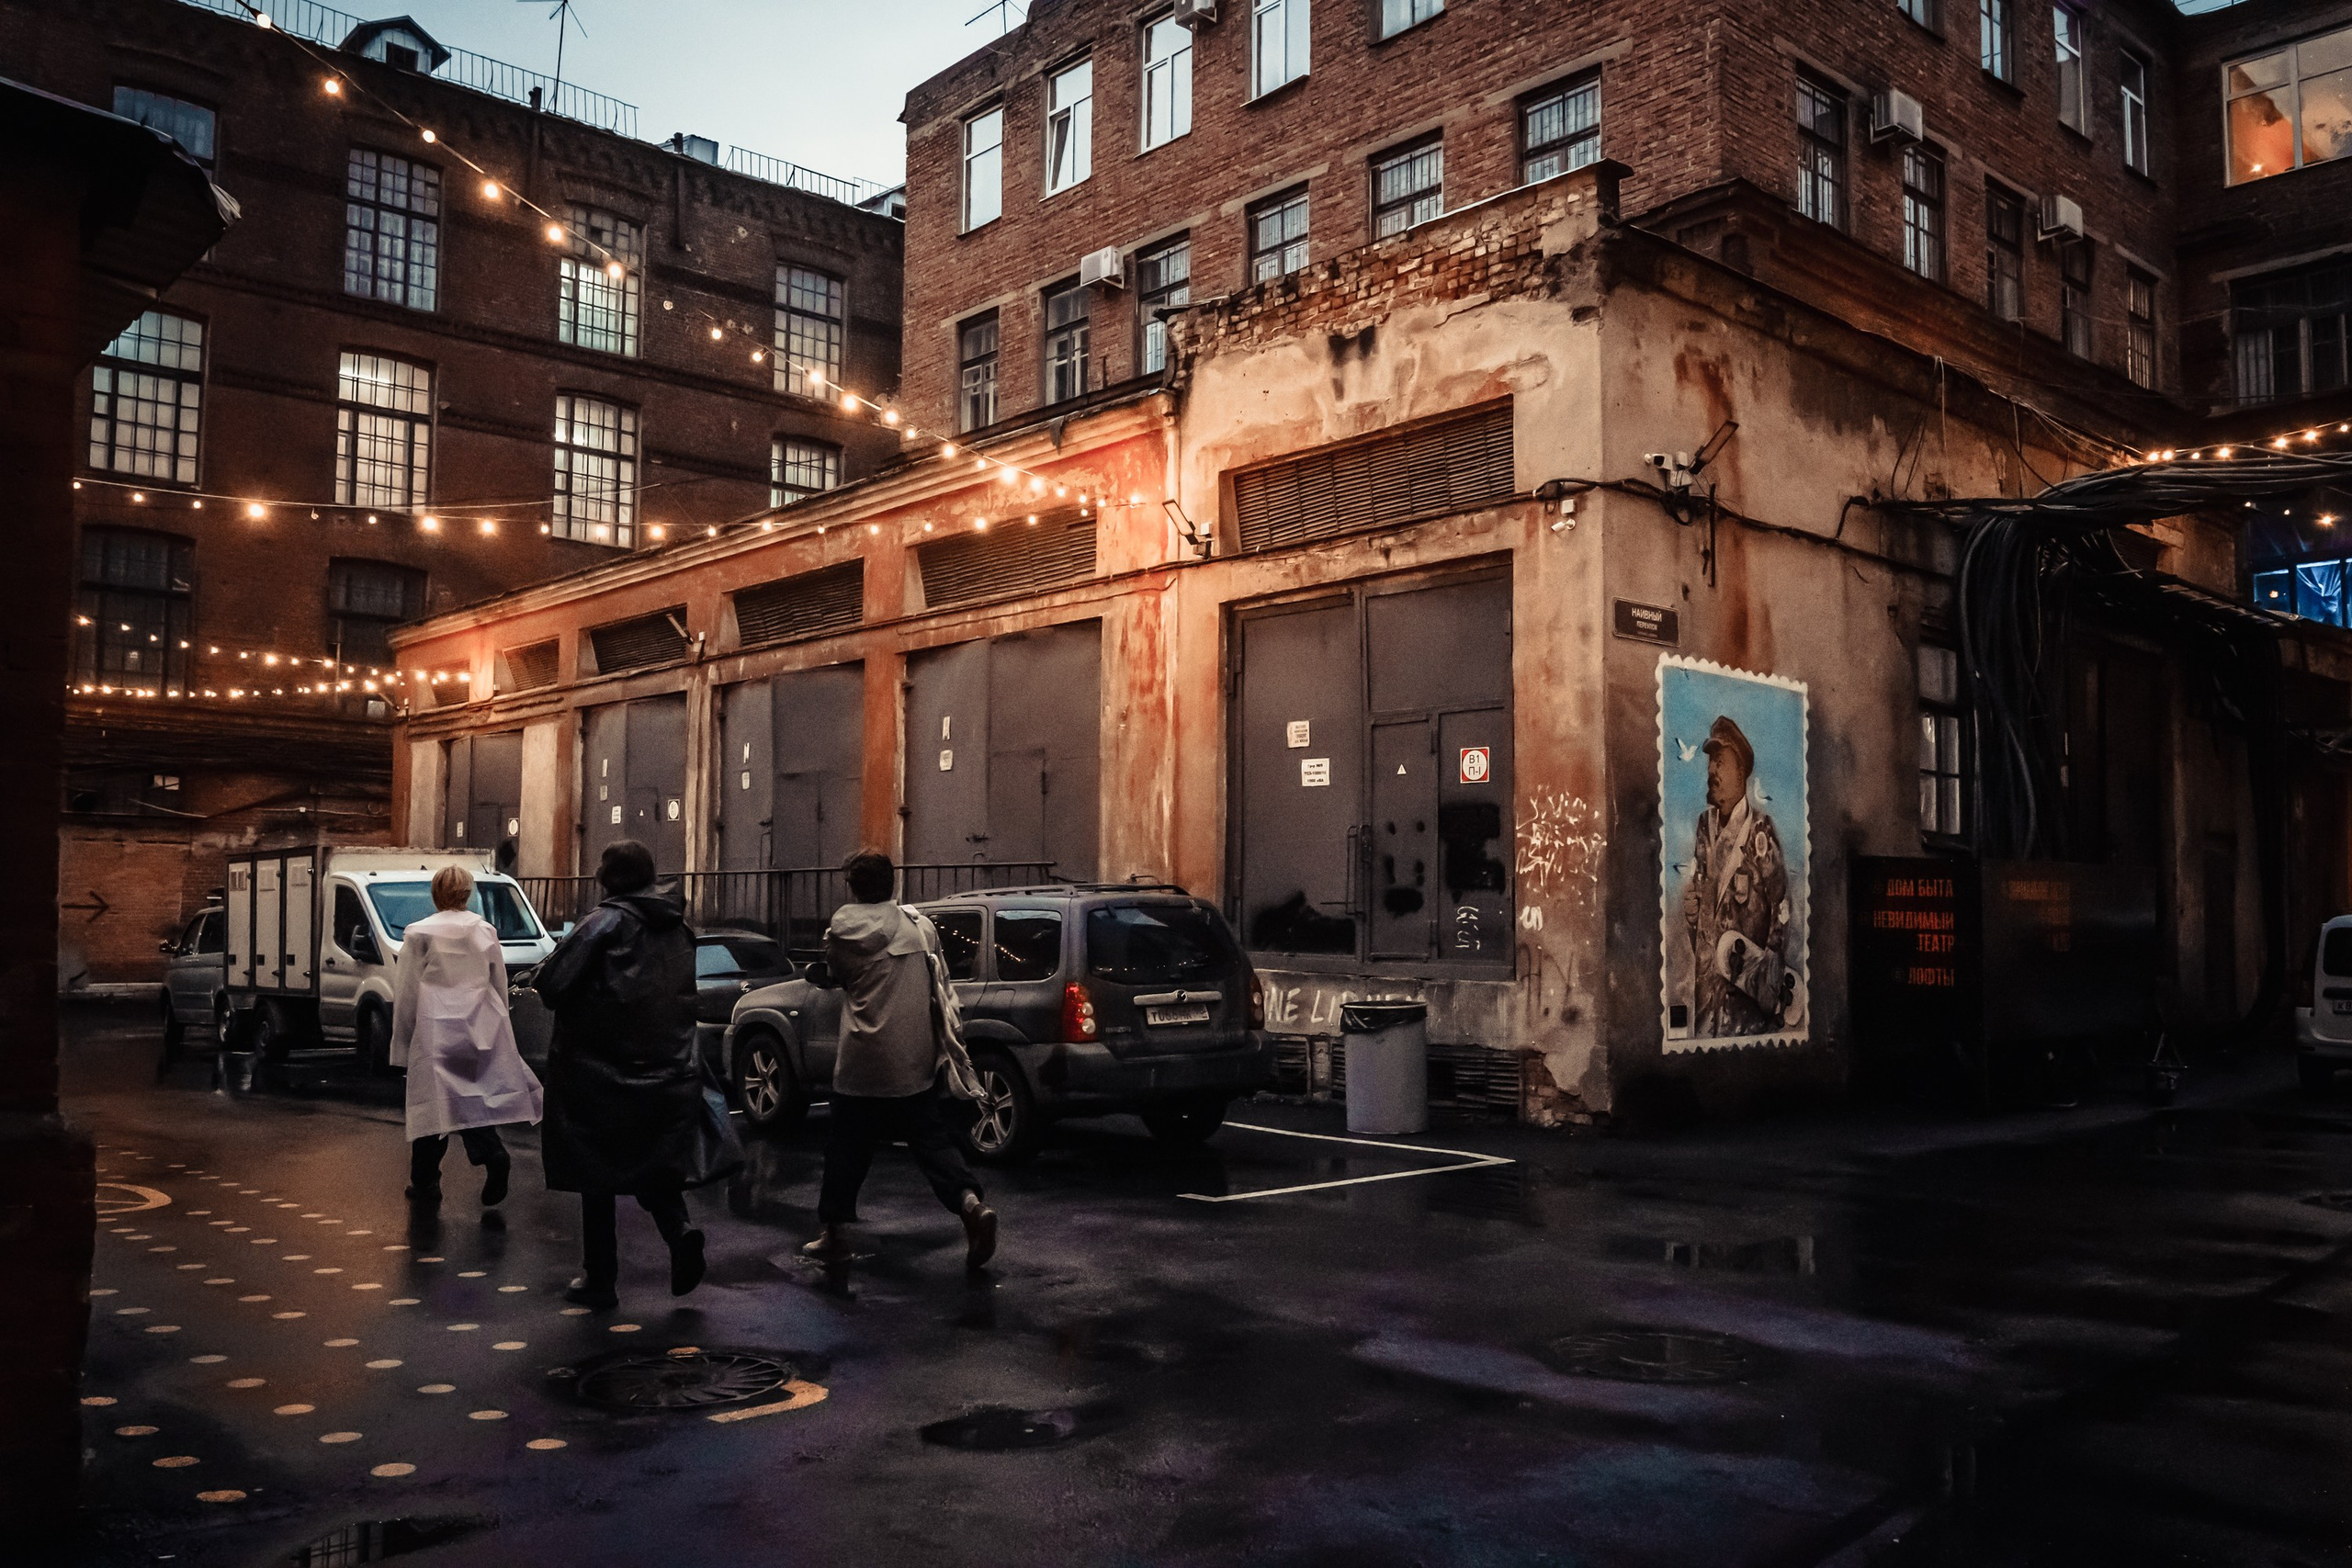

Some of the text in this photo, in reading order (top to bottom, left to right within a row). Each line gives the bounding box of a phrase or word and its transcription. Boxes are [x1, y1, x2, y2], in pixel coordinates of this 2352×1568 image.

[1631, 607, 1663, 622] НАИВНЫЙ
[1886, 878, 1915, 897] ДОМ
[1918, 878, 1954, 897] БЫТА
[1917, 933, 1955, 953] ТЕАТР
[1908, 966, 1955, 987] ЛОФТЫ
